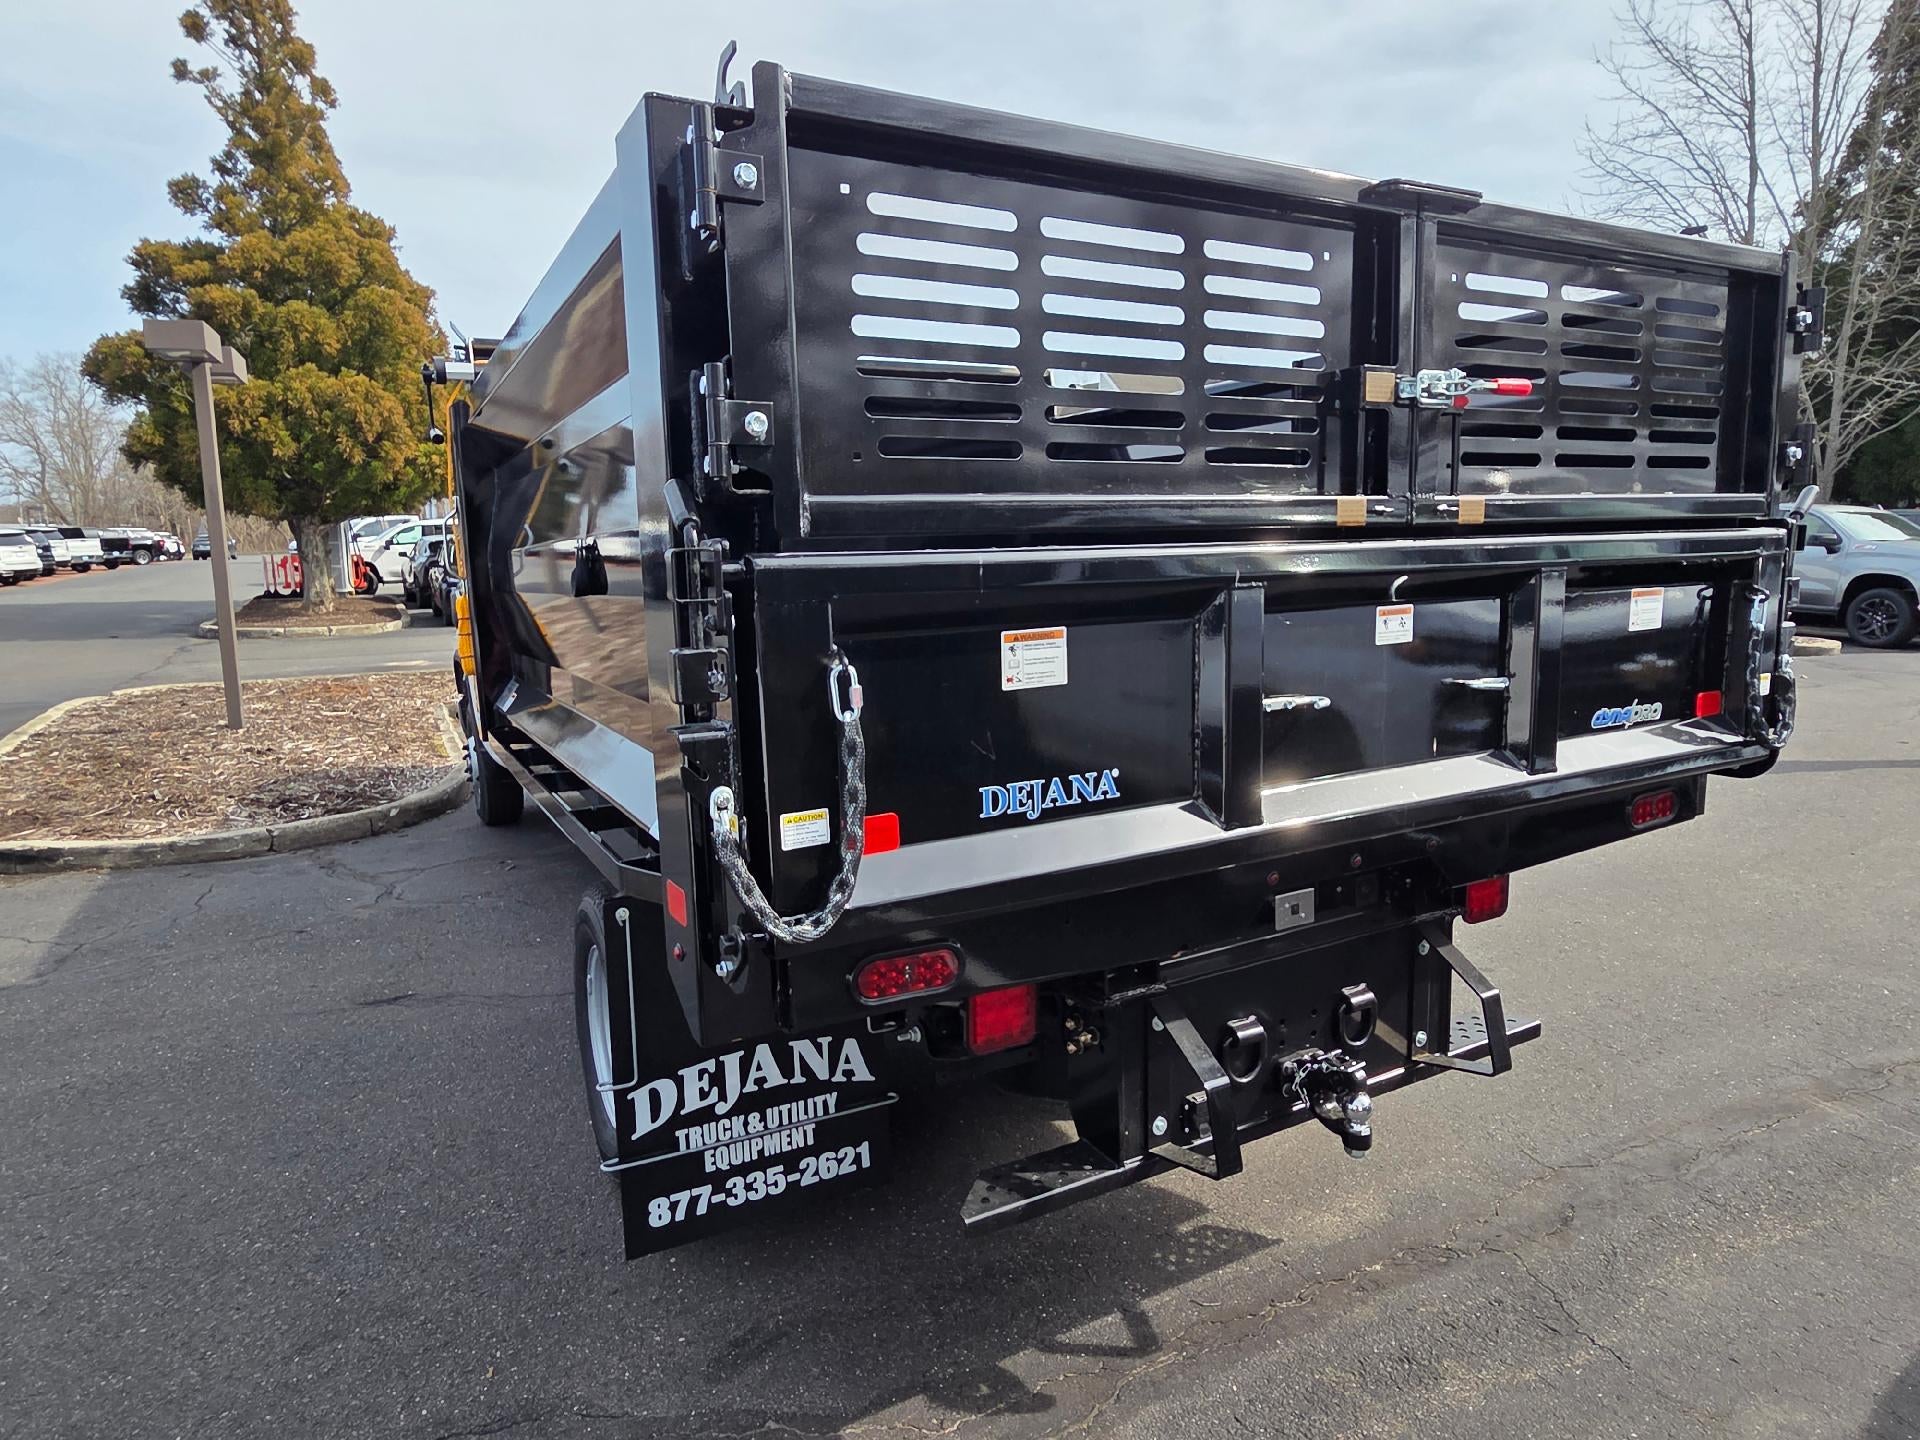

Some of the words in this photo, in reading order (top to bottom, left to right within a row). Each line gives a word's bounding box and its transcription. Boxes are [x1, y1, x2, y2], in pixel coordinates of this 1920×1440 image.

[793, 812, 824, 823] CAUTION
[979, 768, 1120, 820] DEJANA
[627, 1036, 876, 1141] DEJANA
[704, 1123, 816, 1173] EQUIPMENT
[648, 1141, 871, 1228] 877-335-2621
